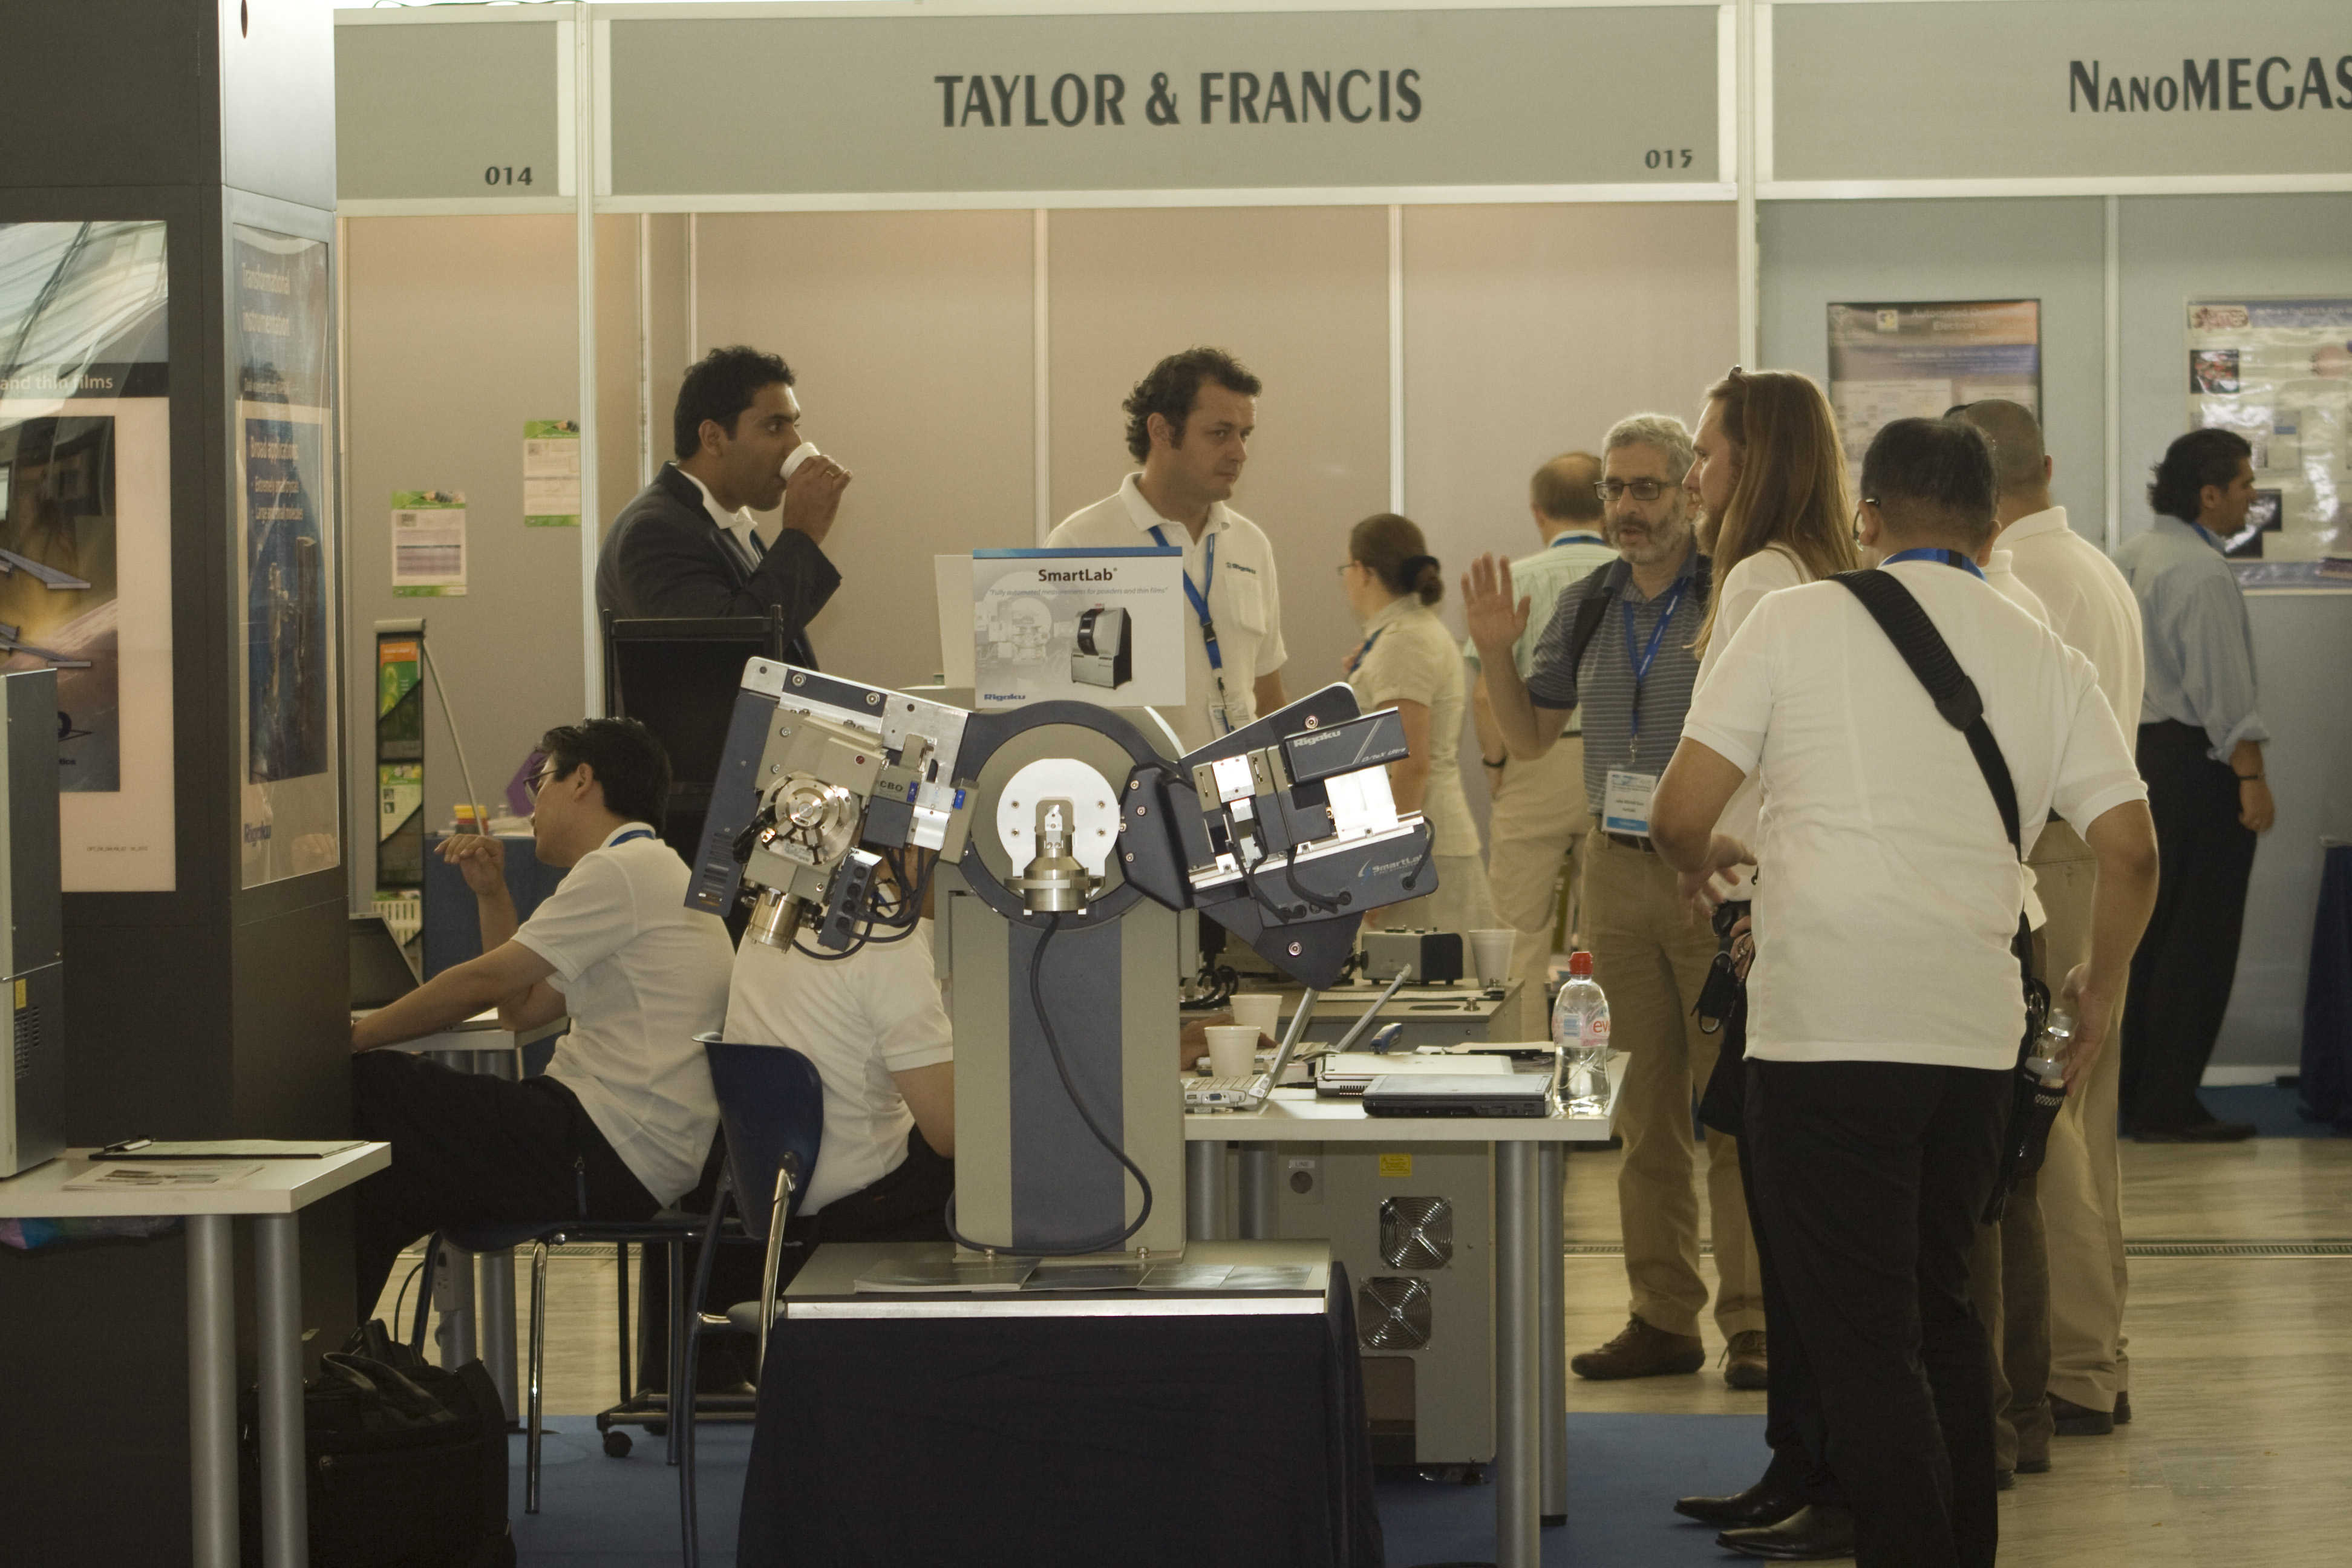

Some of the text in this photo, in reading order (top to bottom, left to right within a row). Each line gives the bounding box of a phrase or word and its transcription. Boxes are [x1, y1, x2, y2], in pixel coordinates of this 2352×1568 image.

[935, 68, 1422, 128] TAYLOR & FRANCIS
[1645, 149, 1692, 170] 015
[485, 166, 533, 186] 014
[984, 693, 1026, 702] Rigaku
[1293, 730, 1341, 748] Rigaku
[880, 780, 903, 792] CBO
